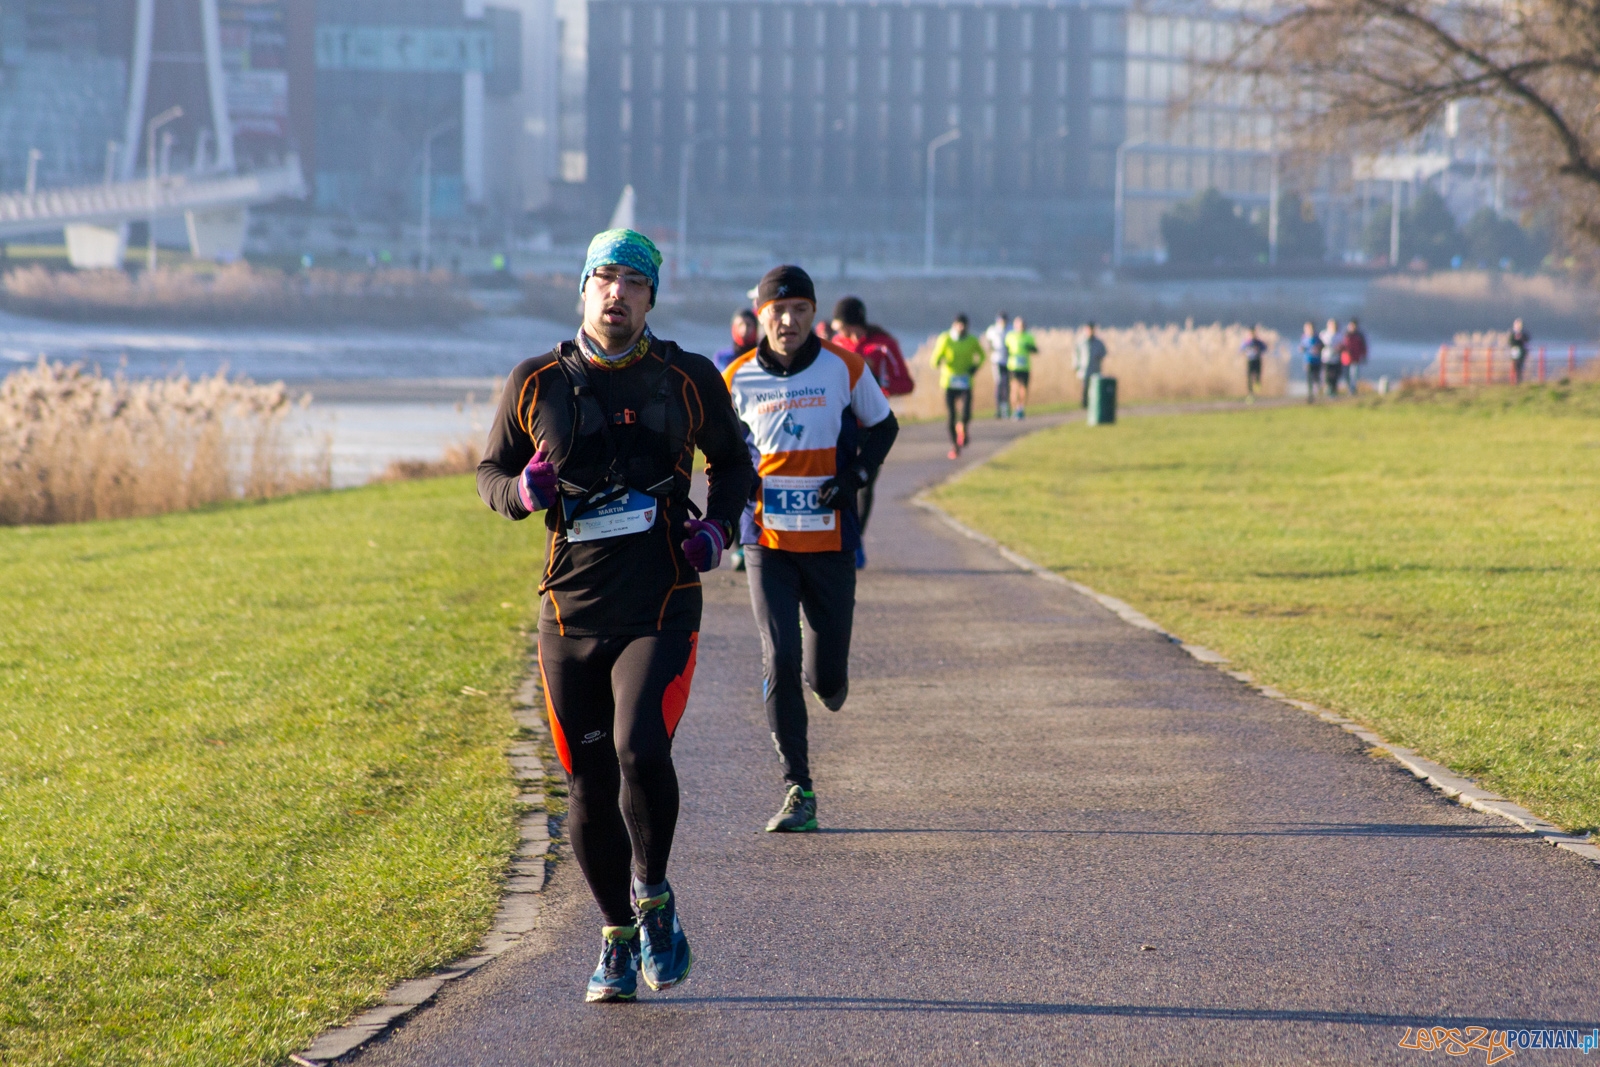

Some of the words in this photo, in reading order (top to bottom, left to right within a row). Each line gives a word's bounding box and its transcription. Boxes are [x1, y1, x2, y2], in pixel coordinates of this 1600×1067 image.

[756, 387, 826, 402] Wielkopolscy
[757, 396, 827, 414] BIEGACZE
[777, 490, 821, 510] 130
[598, 506, 624, 516] MARTIN
